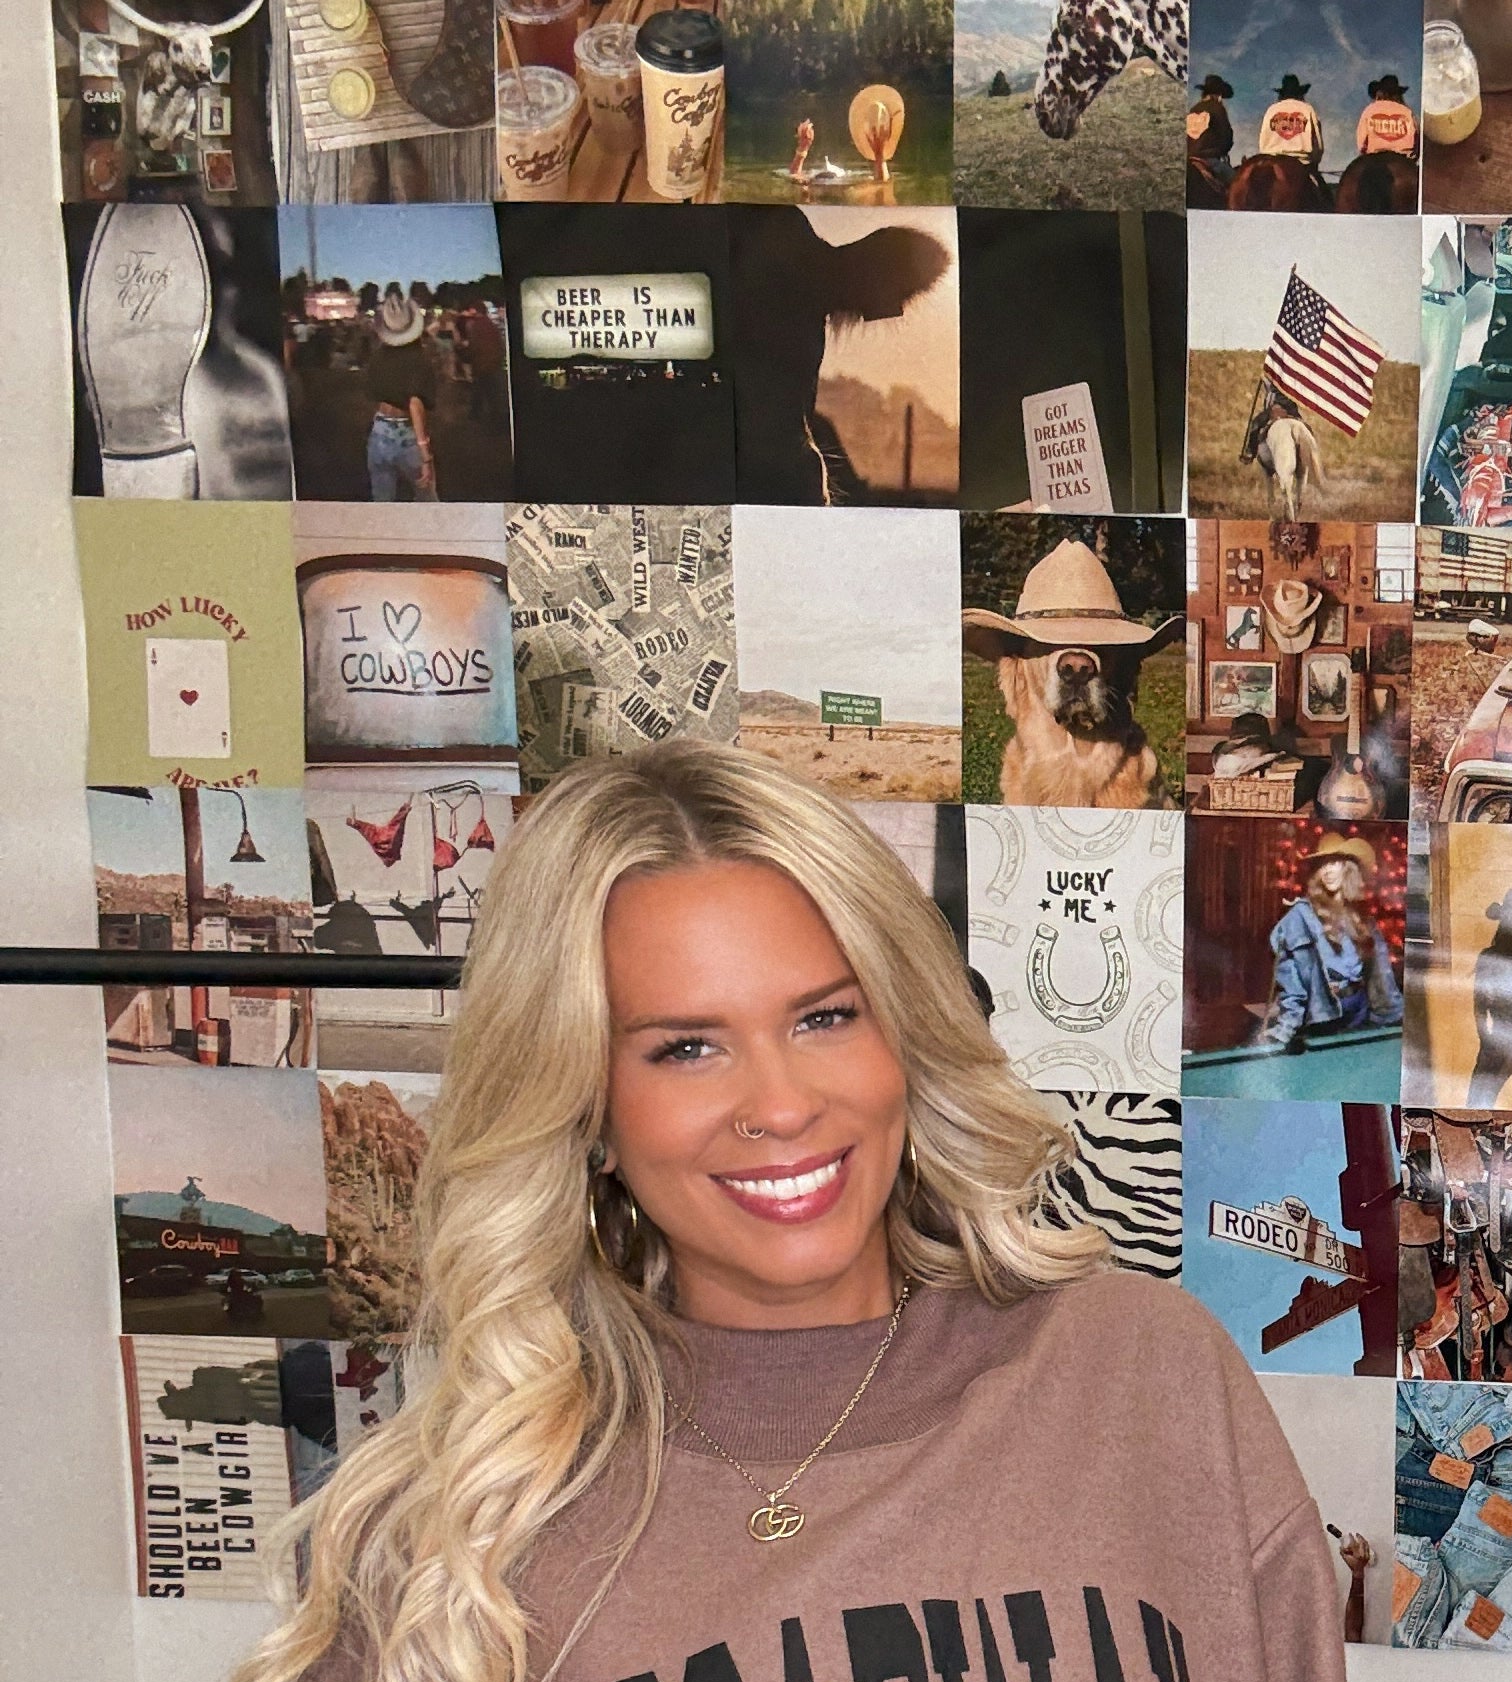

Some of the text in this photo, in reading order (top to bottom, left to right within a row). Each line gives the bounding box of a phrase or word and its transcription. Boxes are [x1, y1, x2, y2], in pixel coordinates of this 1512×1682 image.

[557, 286, 652, 306] BEER IS
[541, 307, 696, 328] CHEAPER THAN
[569, 329, 658, 349] THERAPY
[1045, 403, 1069, 421] GOT
[1034, 417, 1087, 442] DREAMS
[1039, 438, 1088, 460] BIGGER
[1047, 458, 1084, 479] THAN
[1047, 478, 1091, 501] TEXAS
[631, 506, 648, 608] WILD WEST
[677, 527, 701, 585] WANTED
[125, 596, 250, 642] HOW LUCKY
[336, 605, 368, 642] I
[634, 627, 689, 660] RODEO
[341, 648, 494, 689] COWBOYS
[619, 690, 673, 741] COWBOY
[1046, 867, 1114, 897] LUCKY
[1063, 898, 1097, 924] ME
[161, 1228, 219, 1258] Cowboy
[1225, 1208, 1299, 1253] RODEO
[1325, 1238, 1339, 1251] DR
[1325, 1252, 1350, 1273] 500
[215, 1416, 256, 1552] COWGIRL
[182, 1442, 222, 1570] BEEN A
